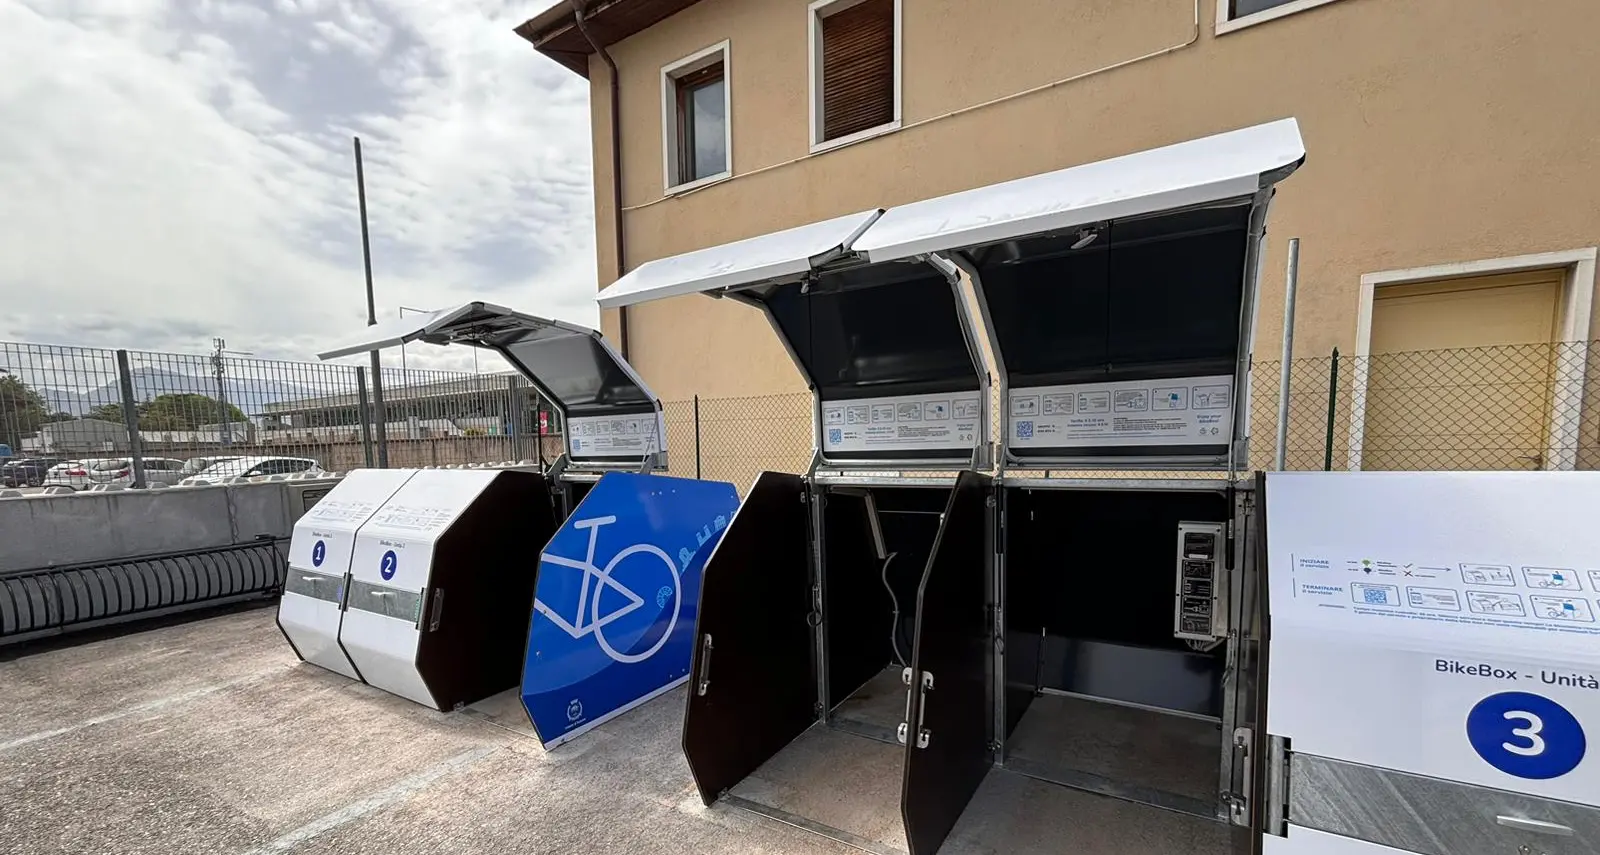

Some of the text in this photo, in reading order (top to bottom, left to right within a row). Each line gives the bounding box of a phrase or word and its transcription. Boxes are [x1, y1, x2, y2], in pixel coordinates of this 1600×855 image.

[315, 546, 322, 561] 1
[384, 556, 392, 574] 2
[1302, 584, 1343, 592] TERMINARE
[1435, 659, 1517, 680] BikeBox
[1541, 670, 1600, 690] Unità
[1502, 710, 1545, 756] 3
